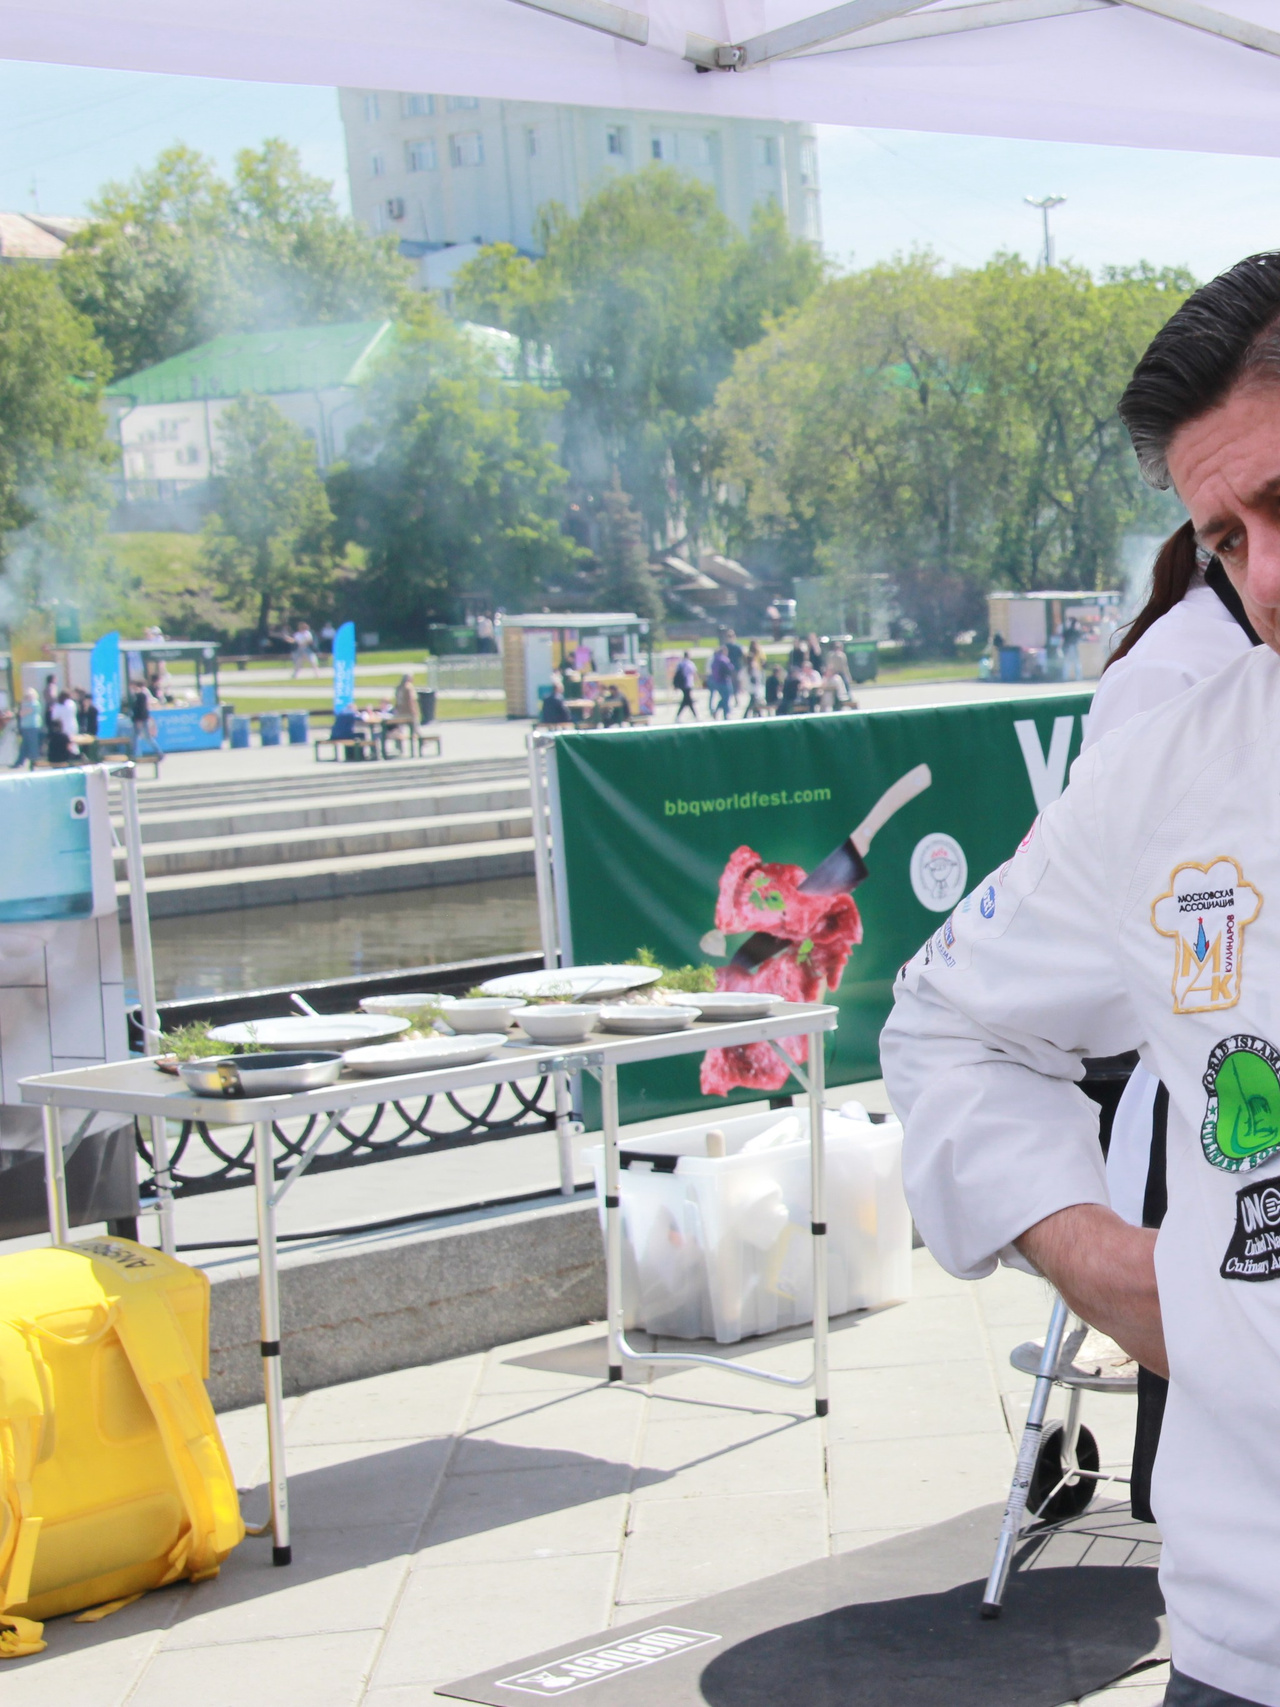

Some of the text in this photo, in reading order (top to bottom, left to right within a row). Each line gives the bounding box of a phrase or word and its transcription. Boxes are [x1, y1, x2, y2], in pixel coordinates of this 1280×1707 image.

[664, 786, 831, 817] bbqworldfest.com
[1177, 888, 1234, 904] МОСКОВСКАЯ
[1179, 898, 1235, 913] АССОЦИАЦИЯ
[1225, 914, 1235, 973] КУЛИНАРОВ
[1225, 1257, 1270, 1275] Culinary
